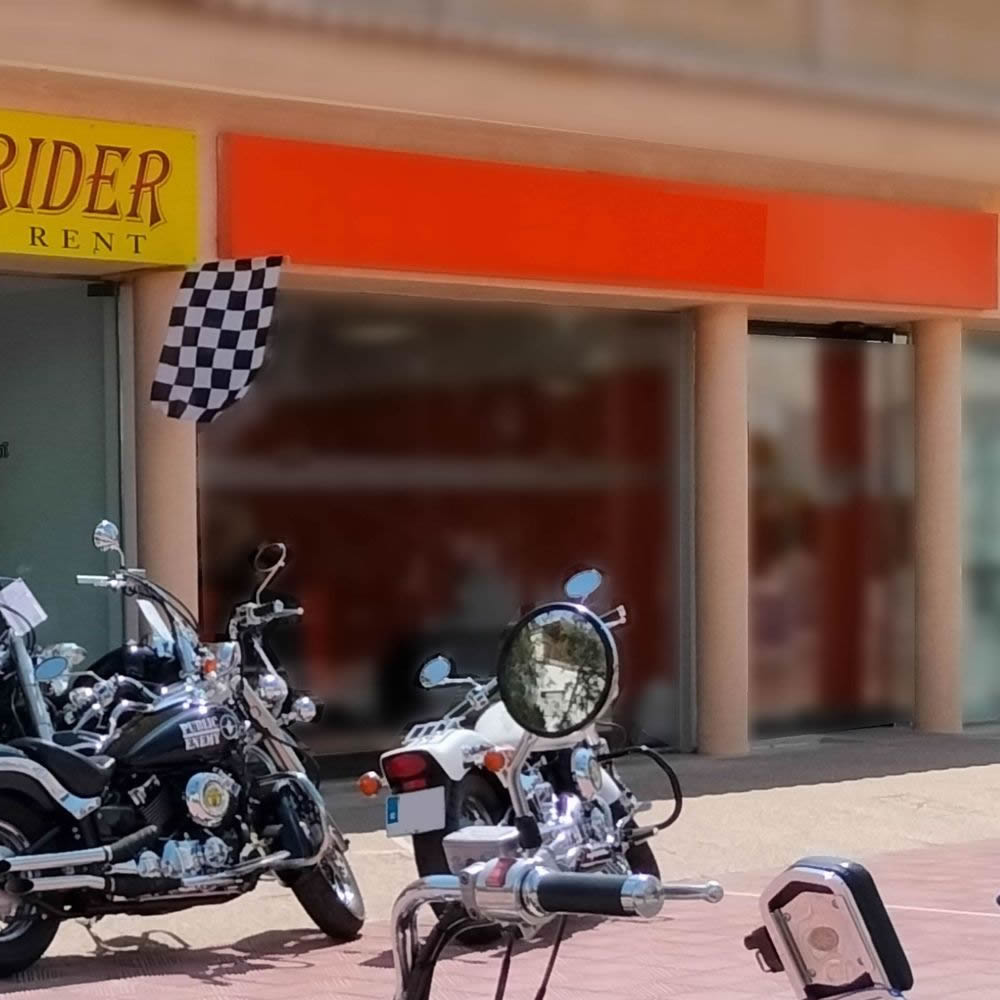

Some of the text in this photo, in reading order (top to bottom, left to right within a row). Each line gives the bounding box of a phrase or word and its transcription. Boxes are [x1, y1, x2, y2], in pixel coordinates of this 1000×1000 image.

[29, 226, 147, 255] RENT
[179, 716, 219, 736] PUBLIC
[184, 731, 221, 751] ENEMY
